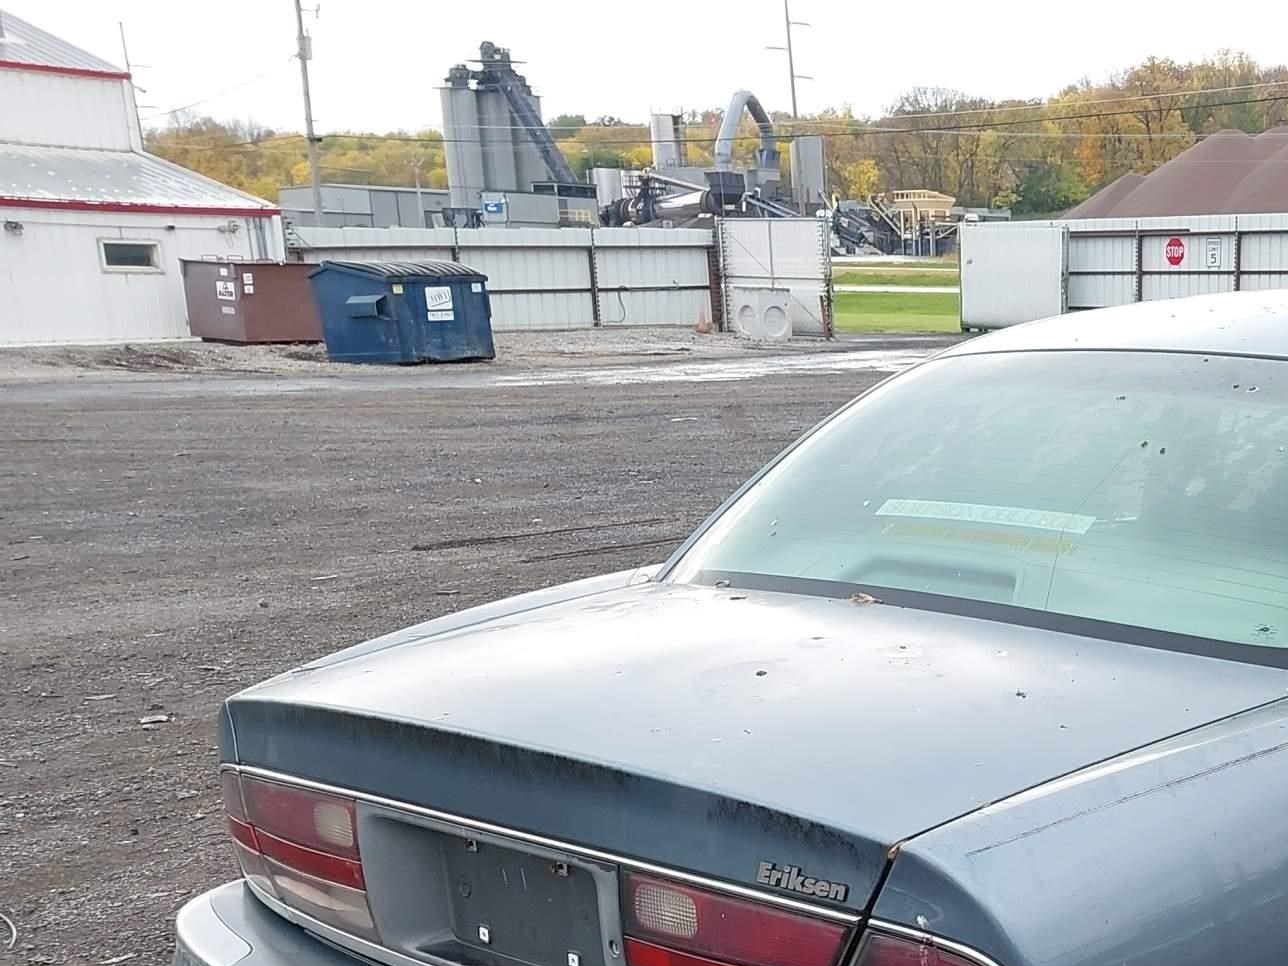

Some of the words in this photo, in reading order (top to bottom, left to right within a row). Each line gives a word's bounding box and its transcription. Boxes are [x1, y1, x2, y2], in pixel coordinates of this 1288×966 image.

[1166, 246, 1184, 258] STOP
[1210, 253, 1217, 264] 5
[757, 860, 848, 902] Eriksen
